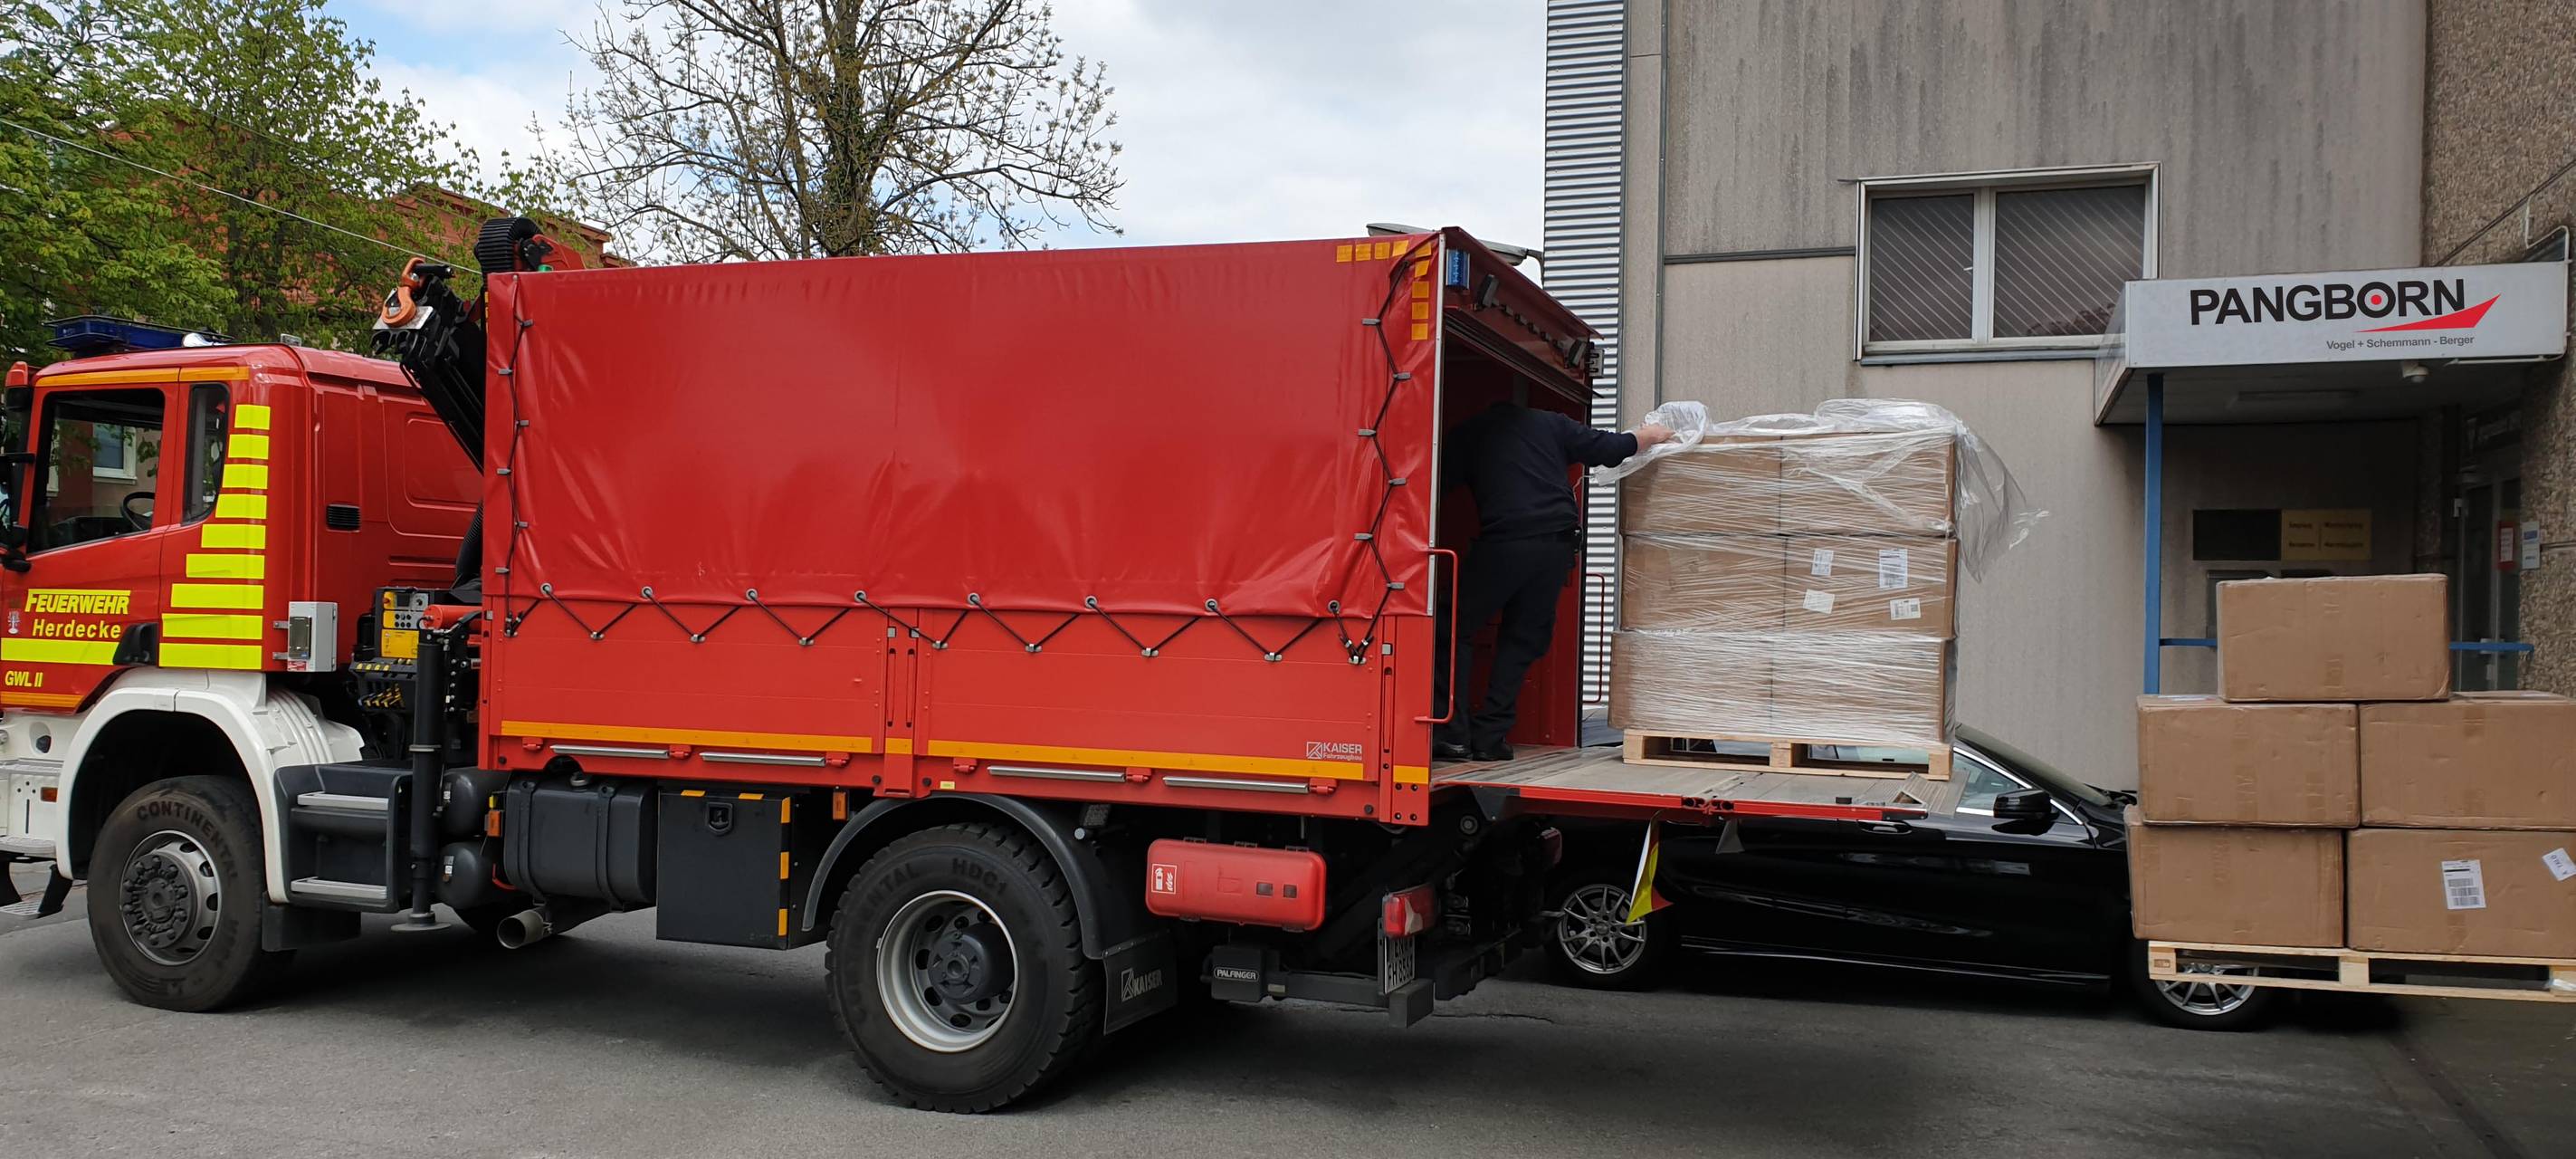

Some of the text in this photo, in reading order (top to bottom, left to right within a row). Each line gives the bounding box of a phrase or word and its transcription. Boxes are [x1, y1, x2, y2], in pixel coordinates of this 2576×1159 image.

[2190, 278, 2465, 325] PANGBORN
[2326, 339, 2355, 350] Vogel
[2366, 337, 2431, 349] Schemmann
[2439, 335, 2475, 349] Berger
[24, 589, 131, 615] FEUERWEHR
[32, 618, 121, 638] Herdecke
[5, 670, 32, 687] GWL
[1323, 742, 1362, 754] KAISER
[1323, 752, 1362, 761] Fahrzeugbau
[1132, 969, 1163, 997] KAISER
[1216, 969, 1256, 980] PALFINGER
